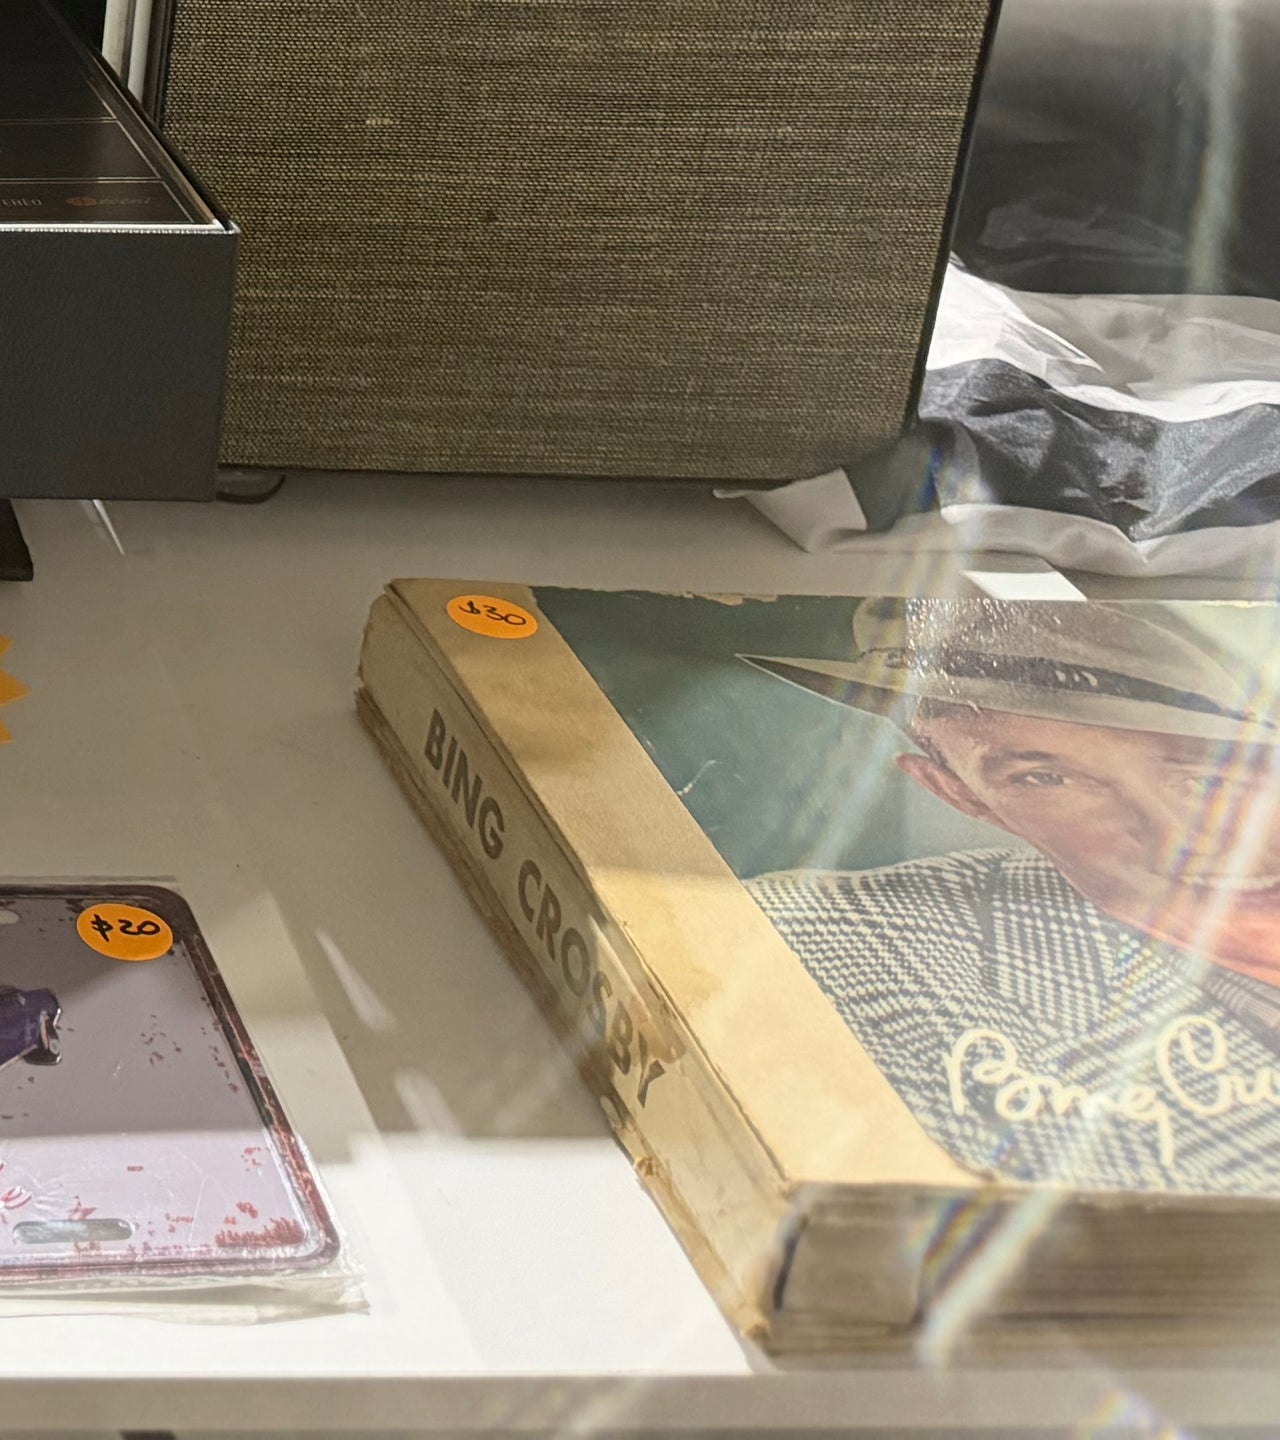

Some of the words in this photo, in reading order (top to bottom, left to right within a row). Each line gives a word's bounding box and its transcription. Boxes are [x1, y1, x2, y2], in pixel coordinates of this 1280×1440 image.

[459, 600, 528, 627] $30
[424, 707, 506, 860] BING
[517, 860, 666, 1108] CROSBY
[92, 912, 162, 938] $20
